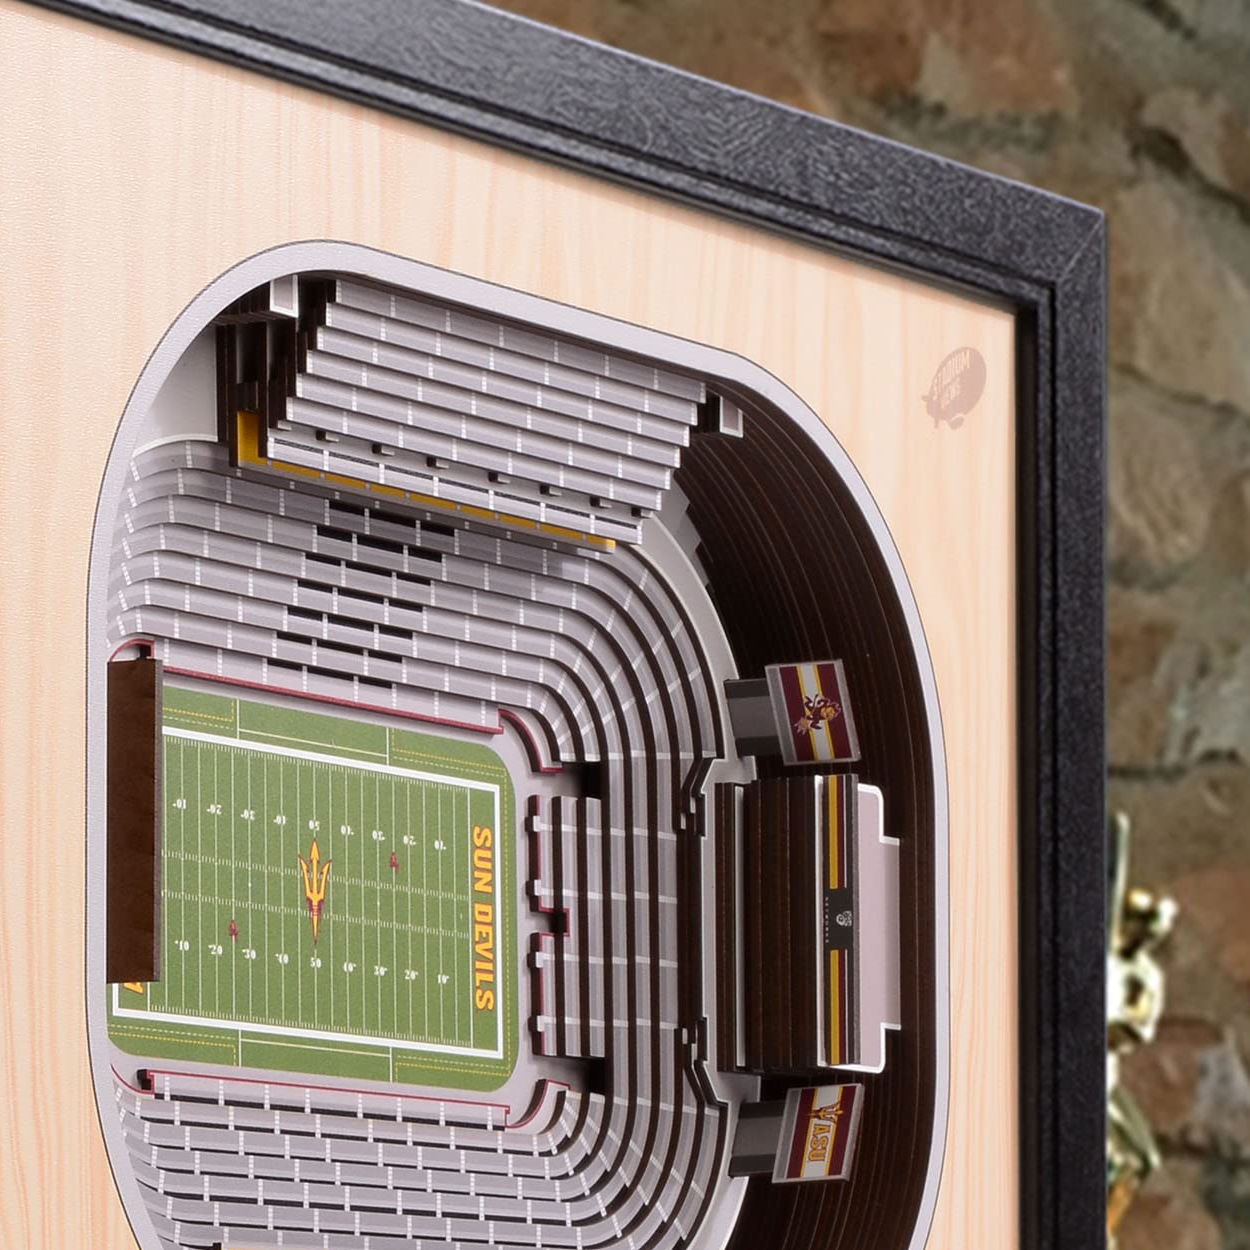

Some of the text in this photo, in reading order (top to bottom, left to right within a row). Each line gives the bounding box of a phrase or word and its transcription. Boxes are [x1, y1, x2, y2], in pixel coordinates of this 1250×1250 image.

[473, 825, 495, 1011] SUN DEVILS
[808, 1124, 831, 1161] ASU
